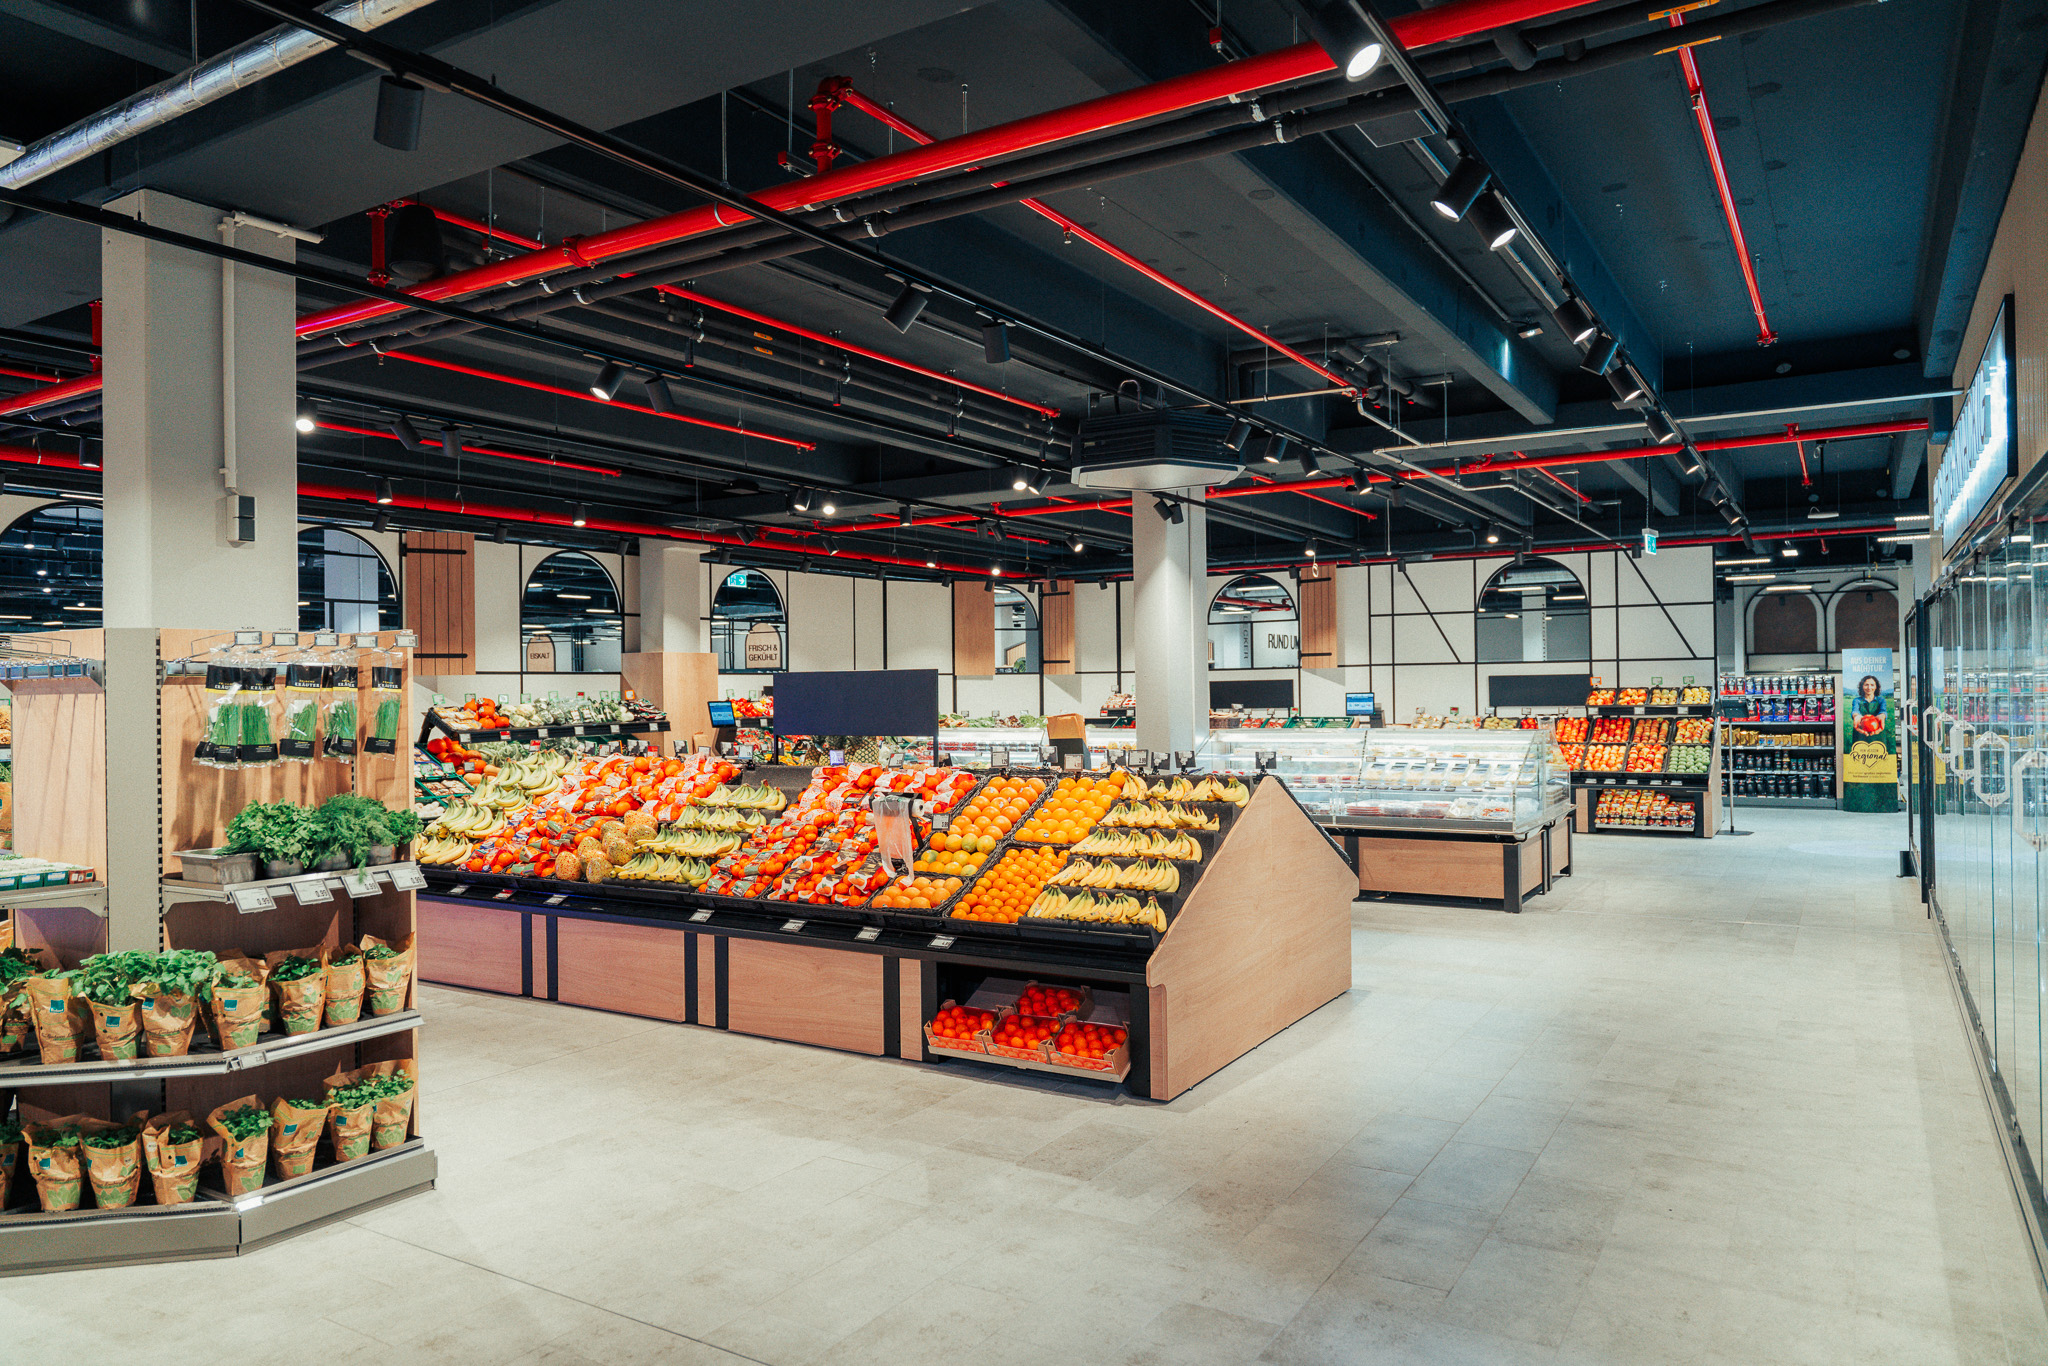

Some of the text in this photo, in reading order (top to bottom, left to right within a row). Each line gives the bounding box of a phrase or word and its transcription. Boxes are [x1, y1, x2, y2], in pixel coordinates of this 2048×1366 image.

[1267, 633, 1289, 649] RUND
[748, 644, 772, 652] FRISCH
[529, 652, 550, 660] EISKALT
[748, 652, 778, 661] GEKÜHLT
[1850, 656, 1887, 665] AUS DEINER
[1850, 751, 1888, 765] Regional
